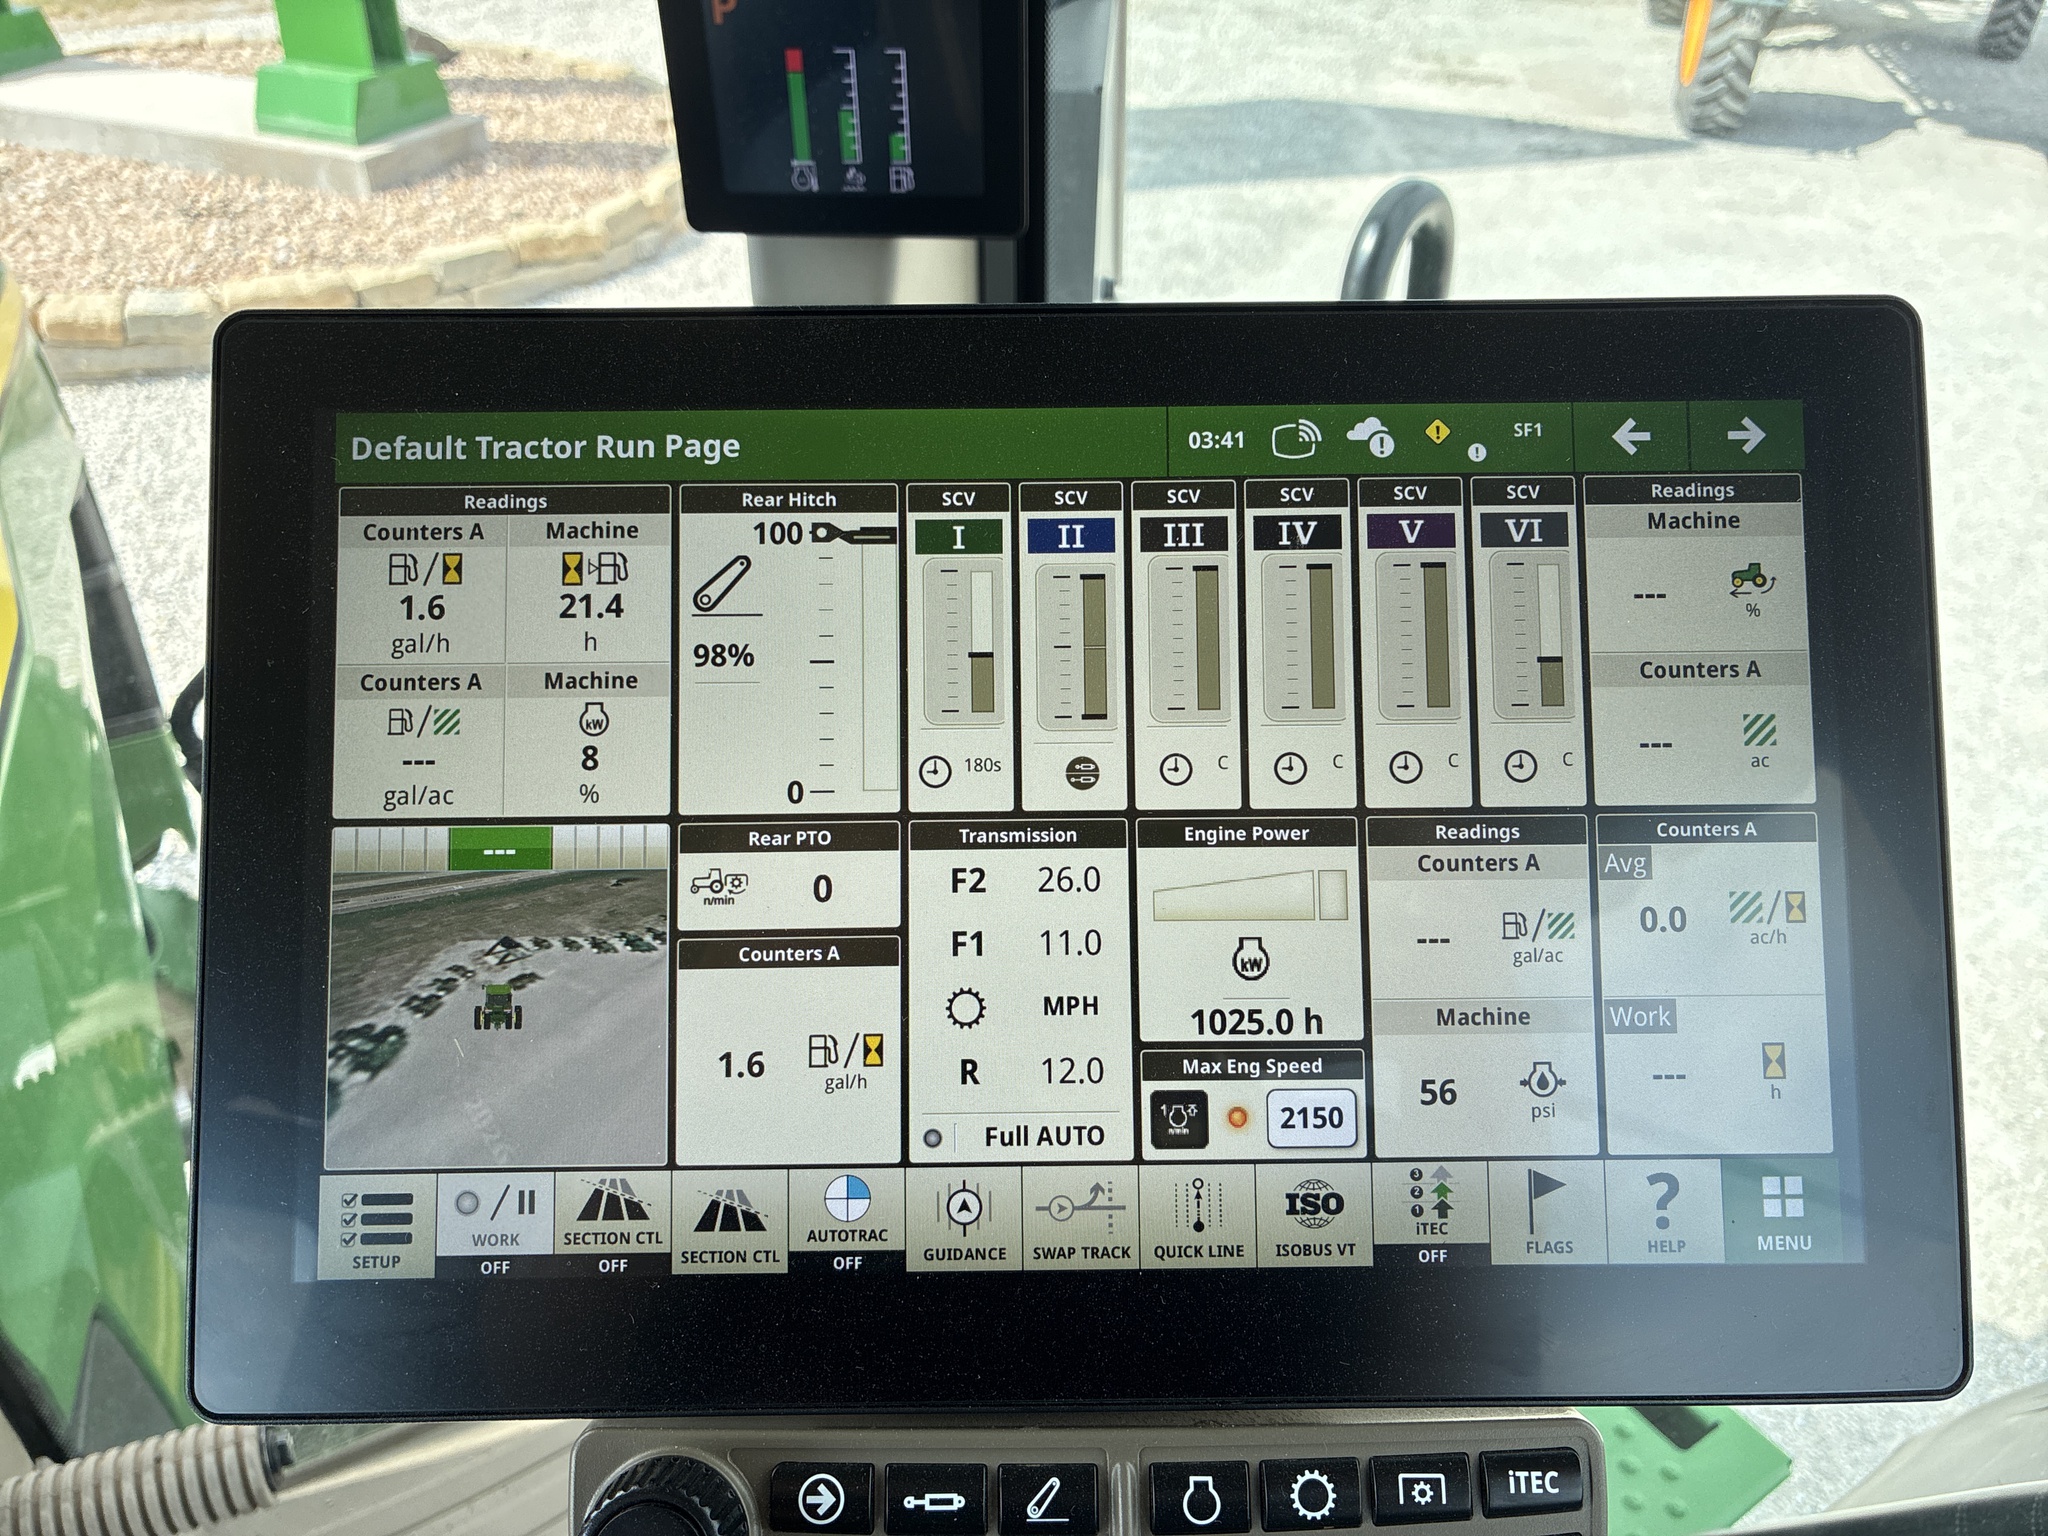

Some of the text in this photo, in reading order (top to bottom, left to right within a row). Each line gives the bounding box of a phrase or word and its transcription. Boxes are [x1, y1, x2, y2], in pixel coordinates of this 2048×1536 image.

[1514, 423, 1541, 437] SF1
[1189, 431, 1243, 449] 03:41
[353, 435, 740, 464] Default Tractor Run Page
[743, 492, 836, 506] Rear Hitch
[943, 492, 975, 506] SCV
[1055, 491, 1087, 505] SCV
[1168, 489, 1200, 503] SCV
[1281, 488, 1314, 501] SCV
[1394, 486, 1427, 500] SCV
[1507, 485, 1539, 499] SCV
[1652, 483, 1734, 501] Readings
[465, 494, 547, 512] Readings
[1648, 511, 1740, 529] Machine
[364, 523, 484, 541] Counters A
[547, 521, 638, 539] Machine
[754, 522, 803, 545] 100
[1058, 525, 1084, 548] II
[1164, 523, 1204, 547] III
[1278, 522, 1317, 545] IV
[1399, 520, 1424, 543] V
[1505, 519, 1542, 542] VI
[400, 595, 445, 620] 1.6
[560, 593, 624, 618] 21.4
[1746, 603, 1760, 617] %
[391, 633, 449, 659] gal/h
[585, 631, 596, 651] h
[694, 644, 754, 667] 98%
[1640, 661, 1761, 679] Counters A
[361, 673, 482, 691] Counters A
[545, 671, 637, 689] Machine
[582, 745, 598, 771] 8
[965, 758, 1001, 772] 180s
[1218, 756, 1228, 769] C
[1333, 755, 1343, 768] C
[1449, 753, 1458, 767] C
[1563, 752, 1573, 766] C
[1752, 757, 1769, 767] ac
[383, 785, 453, 811] gal/ac
[580, 784, 599, 803] %
[788, 781, 803, 804] 0
[749, 831, 831, 846] Rear PTO
[959, 828, 1076, 843] Transmission
[1185, 826, 1309, 845] Engine Power
[1436, 824, 1520, 842] Readings
[1657, 822, 1757, 837] Counters A
[1418, 854, 1540, 872] Counters A
[1605, 854, 1646, 878] Avg
[952, 868, 986, 893] F2
[1039, 866, 1100, 892] 26.0
[814, 875, 832, 903] 0
[704, 895, 734, 905] n/min
[1640, 906, 1686, 932] 0.0
[953, 931, 982, 956] F1
[1041, 929, 1101, 956] 11.0
[1751, 929, 1786, 944] ac/h
[739, 946, 840, 962] Counters A
[1513, 948, 1563, 967] gal/ac
[1044, 996, 1098, 1015] MPH
[1191, 1007, 1322, 1035] 1025.0 h
[1437, 1007, 1530, 1026] Machine
[1610, 1005, 1671, 1026] Work
[719, 1051, 764, 1078] 1.6
[961, 1059, 980, 1084] R
[1042, 1057, 1103, 1084] 12.0
[1183, 1058, 1322, 1077] Max Eng Speed
[825, 1074, 866, 1094] gal/h
[1421, 1079, 1457, 1105] 56
[1771, 1084, 1781, 1099] h
[1281, 1107, 1343, 1129] 2150
[1532, 1106, 1555, 1122] psi
[986, 1125, 1104, 1146] Full AUTO
[1286, 1191, 1344, 1215] ISO
[807, 1229, 887, 1242] AUTOTRAC
[1417, 1222, 1448, 1235] iTEC
[472, 1234, 519, 1246] WORK
[564, 1232, 663, 1245] SECTION CTL
[1527, 1241, 1573, 1254] FLAGS
[1648, 1240, 1686, 1253] HELP
[1758, 1236, 1811, 1250] MENU
[681, 1250, 780, 1263] SECTION CTL
[924, 1248, 1006, 1261] GUIDANCE
[1033, 1246, 1131, 1260] SWAP TRACK
[1154, 1245, 1244, 1261] QUICK LINE
[1276, 1244, 1356, 1256] ISOBUS VT
[1419, 1250, 1447, 1262] OFF
[353, 1256, 400, 1269] SETUP
[481, 1261, 510, 1274] OFF
[599, 1260, 627, 1272] OFF
[834, 1257, 862, 1270] OFF
[1508, 1469, 1559, 1494] iTEC
